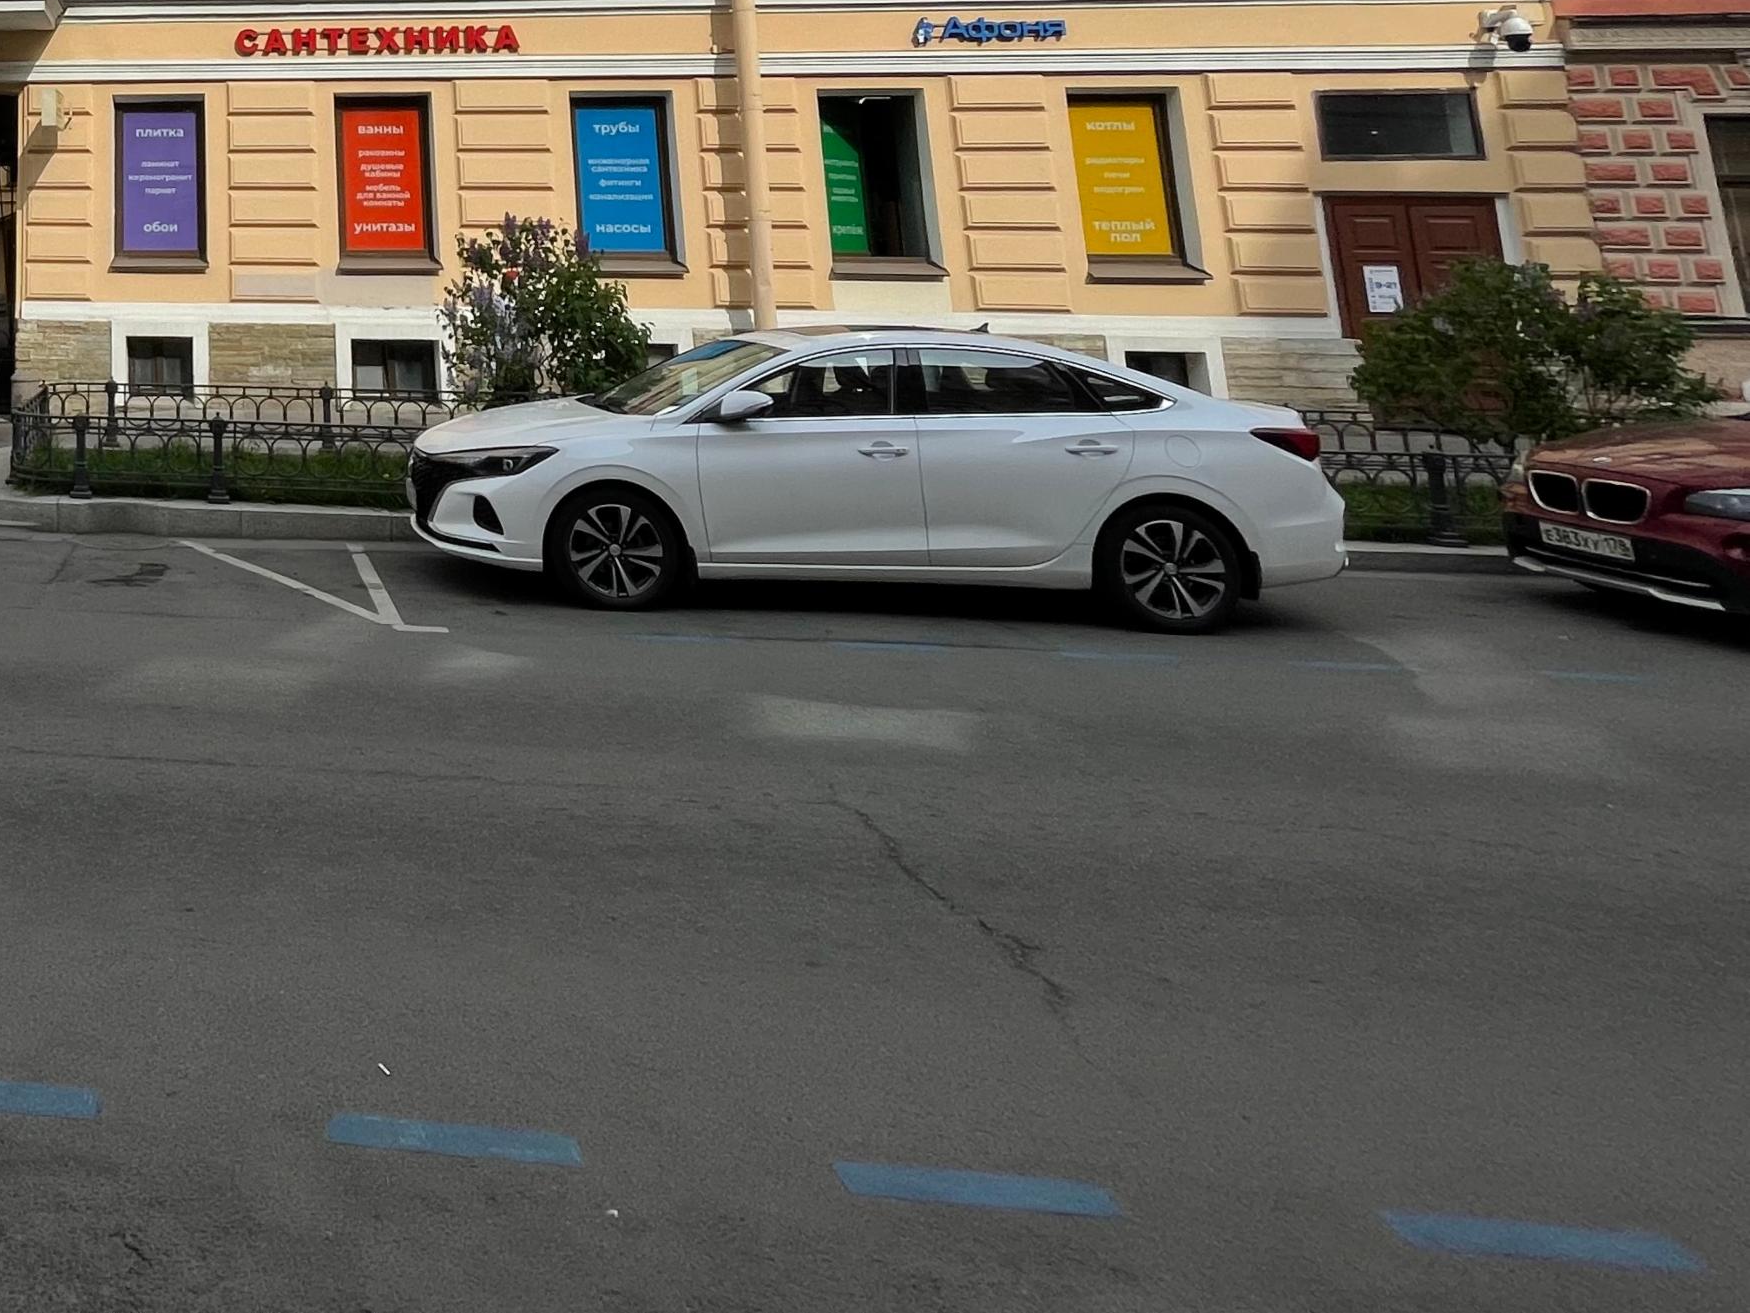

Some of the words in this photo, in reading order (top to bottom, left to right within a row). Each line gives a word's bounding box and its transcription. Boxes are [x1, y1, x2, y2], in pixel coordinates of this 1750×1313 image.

[941, 16, 1066, 43] Афоня
[234, 25, 521, 56] САНТЕХНИКА
[357, 125, 404, 135] ванны
[592, 121, 640, 136] трубы
[1086, 121, 1135, 131] котлы
[135, 128, 185, 138] плитка
[358, 149, 405, 158] раковины
[360, 163, 404, 171] душевые
[364, 169, 401, 178] кабины
[365, 183, 401, 191] мебель
[356, 192, 374, 200] для
[376, 191, 411, 199] ванной
[363, 199, 405, 207] комнаты
[143, 221, 178, 233] обои
[354, 223, 416, 234] унитазы
[595, 224, 651, 233] насосы
[1110, 233, 1141, 243] пол
